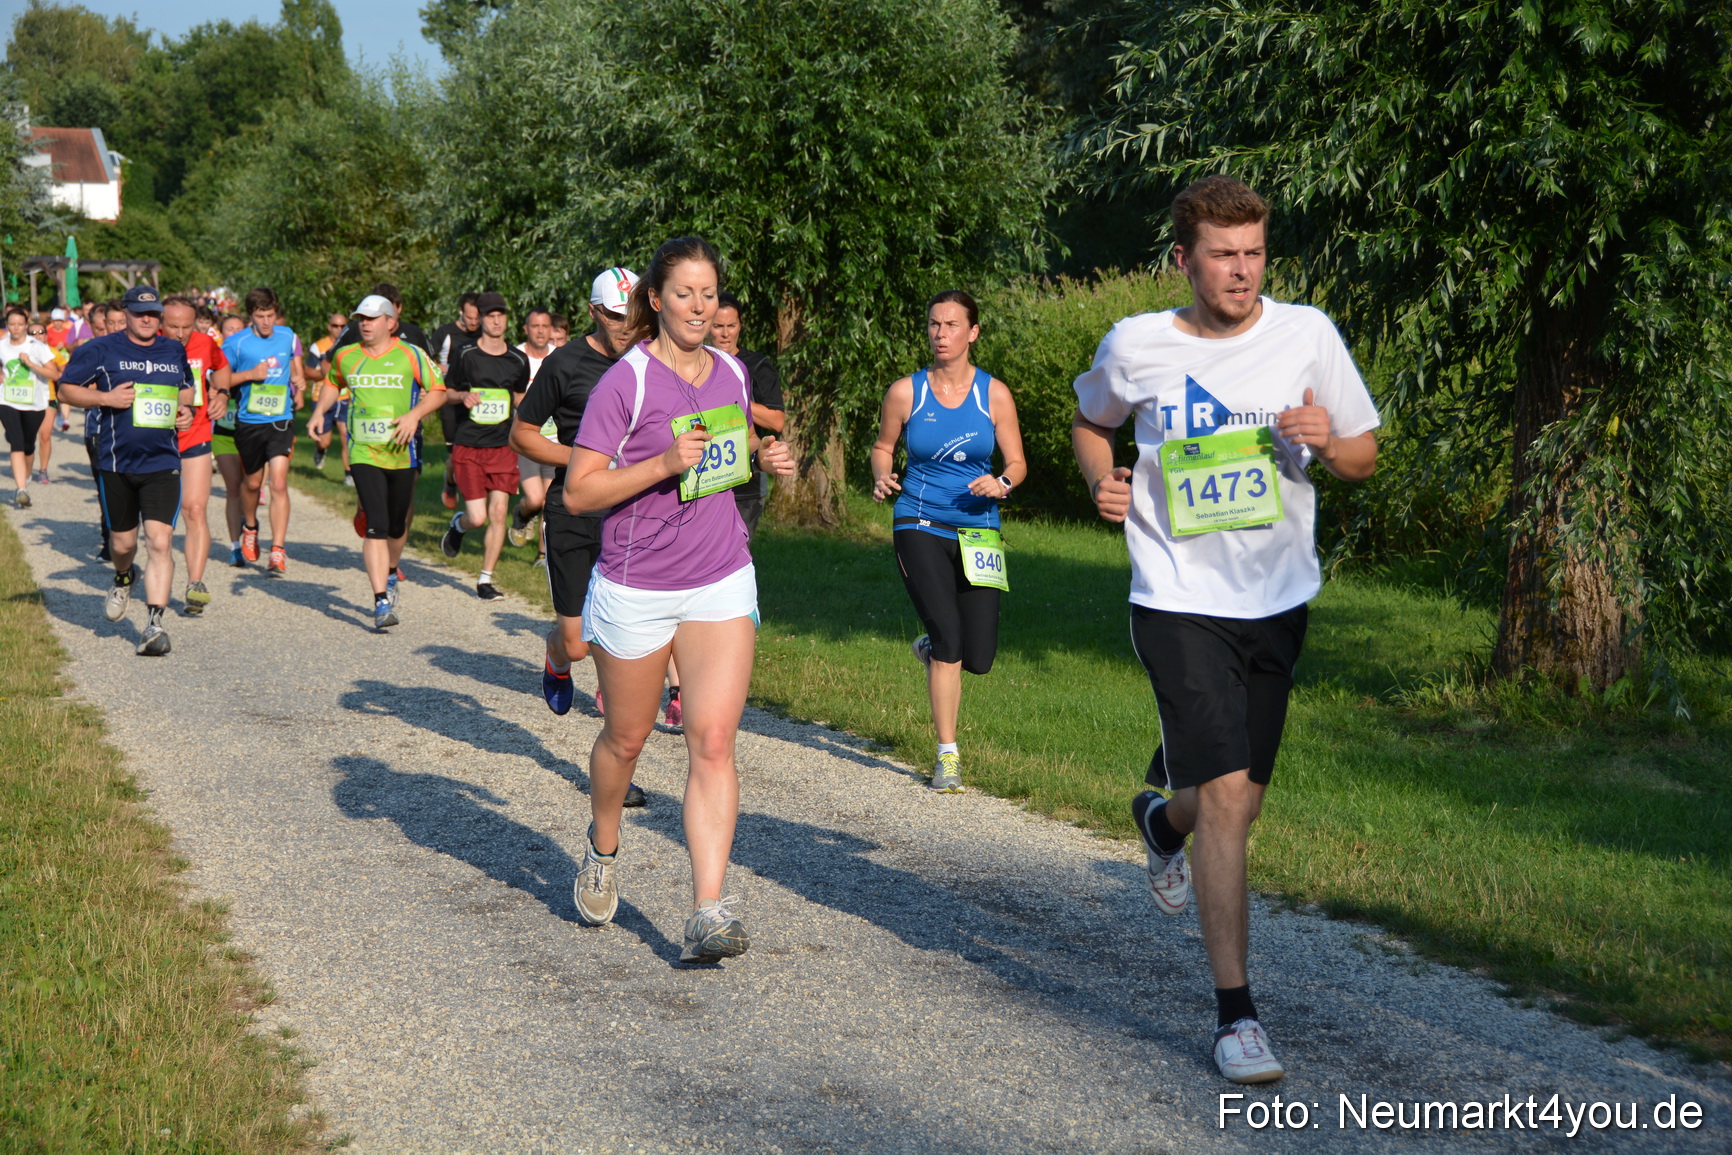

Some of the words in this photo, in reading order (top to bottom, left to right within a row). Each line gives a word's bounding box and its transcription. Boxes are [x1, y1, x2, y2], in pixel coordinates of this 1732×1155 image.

[119, 360, 145, 371] EURO
[153, 363, 179, 374] POLES
[346, 373, 404, 389] BOCK
[11, 387, 28, 397] 128
[144, 401, 171, 416] 369
[256, 396, 279, 407] 498
[475, 403, 505, 414] 1231
[360, 421, 386, 434] 143
[930, 447, 944, 460] Team
[943, 435, 965, 449] Schick
[1177, 467, 1267, 507] 1473
[1195, 510, 1229, 520] Sebastian
[974, 551, 1002, 573] 840
